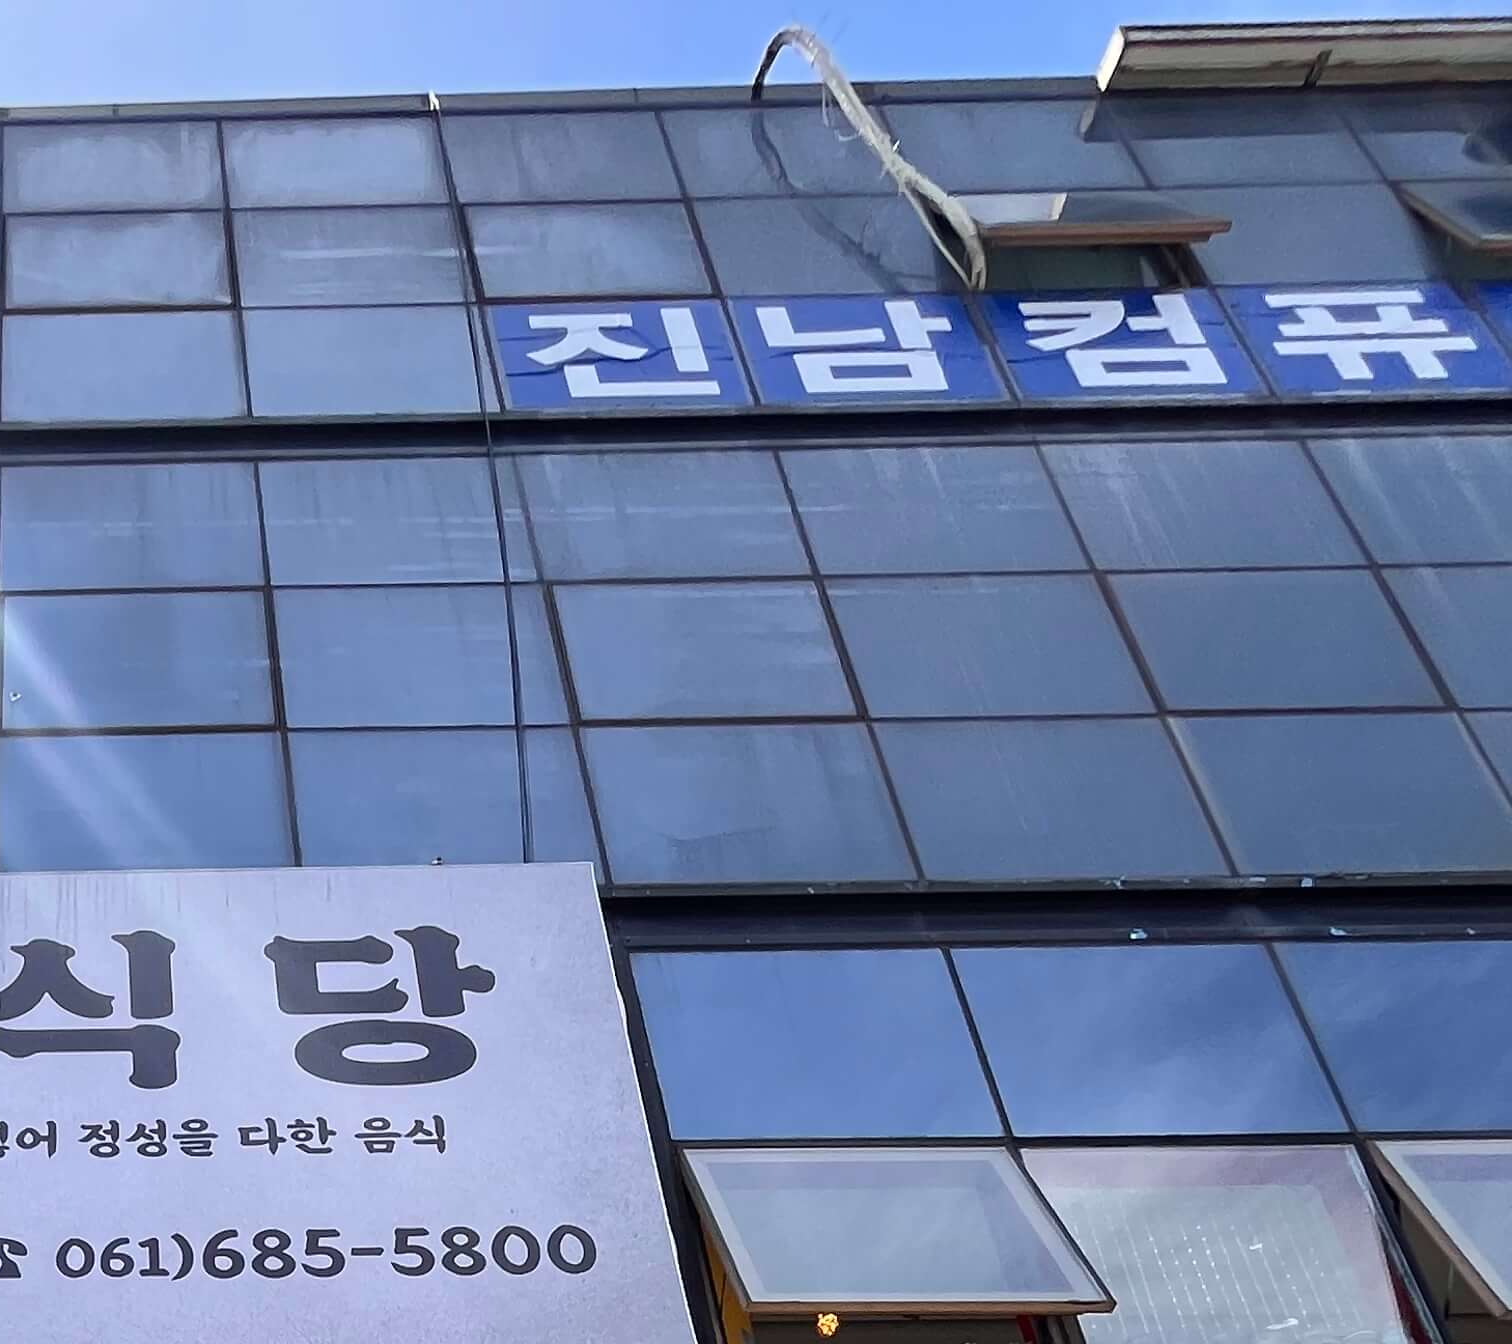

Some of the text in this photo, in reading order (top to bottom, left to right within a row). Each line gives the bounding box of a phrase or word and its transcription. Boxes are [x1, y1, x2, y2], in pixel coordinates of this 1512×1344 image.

[79, 1116, 217, 1158] 정성을
[239, 1116, 335, 1156] 다한
[355, 1115, 447, 1155] 음식
[57, 1222, 598, 1284] 061)685-5800
